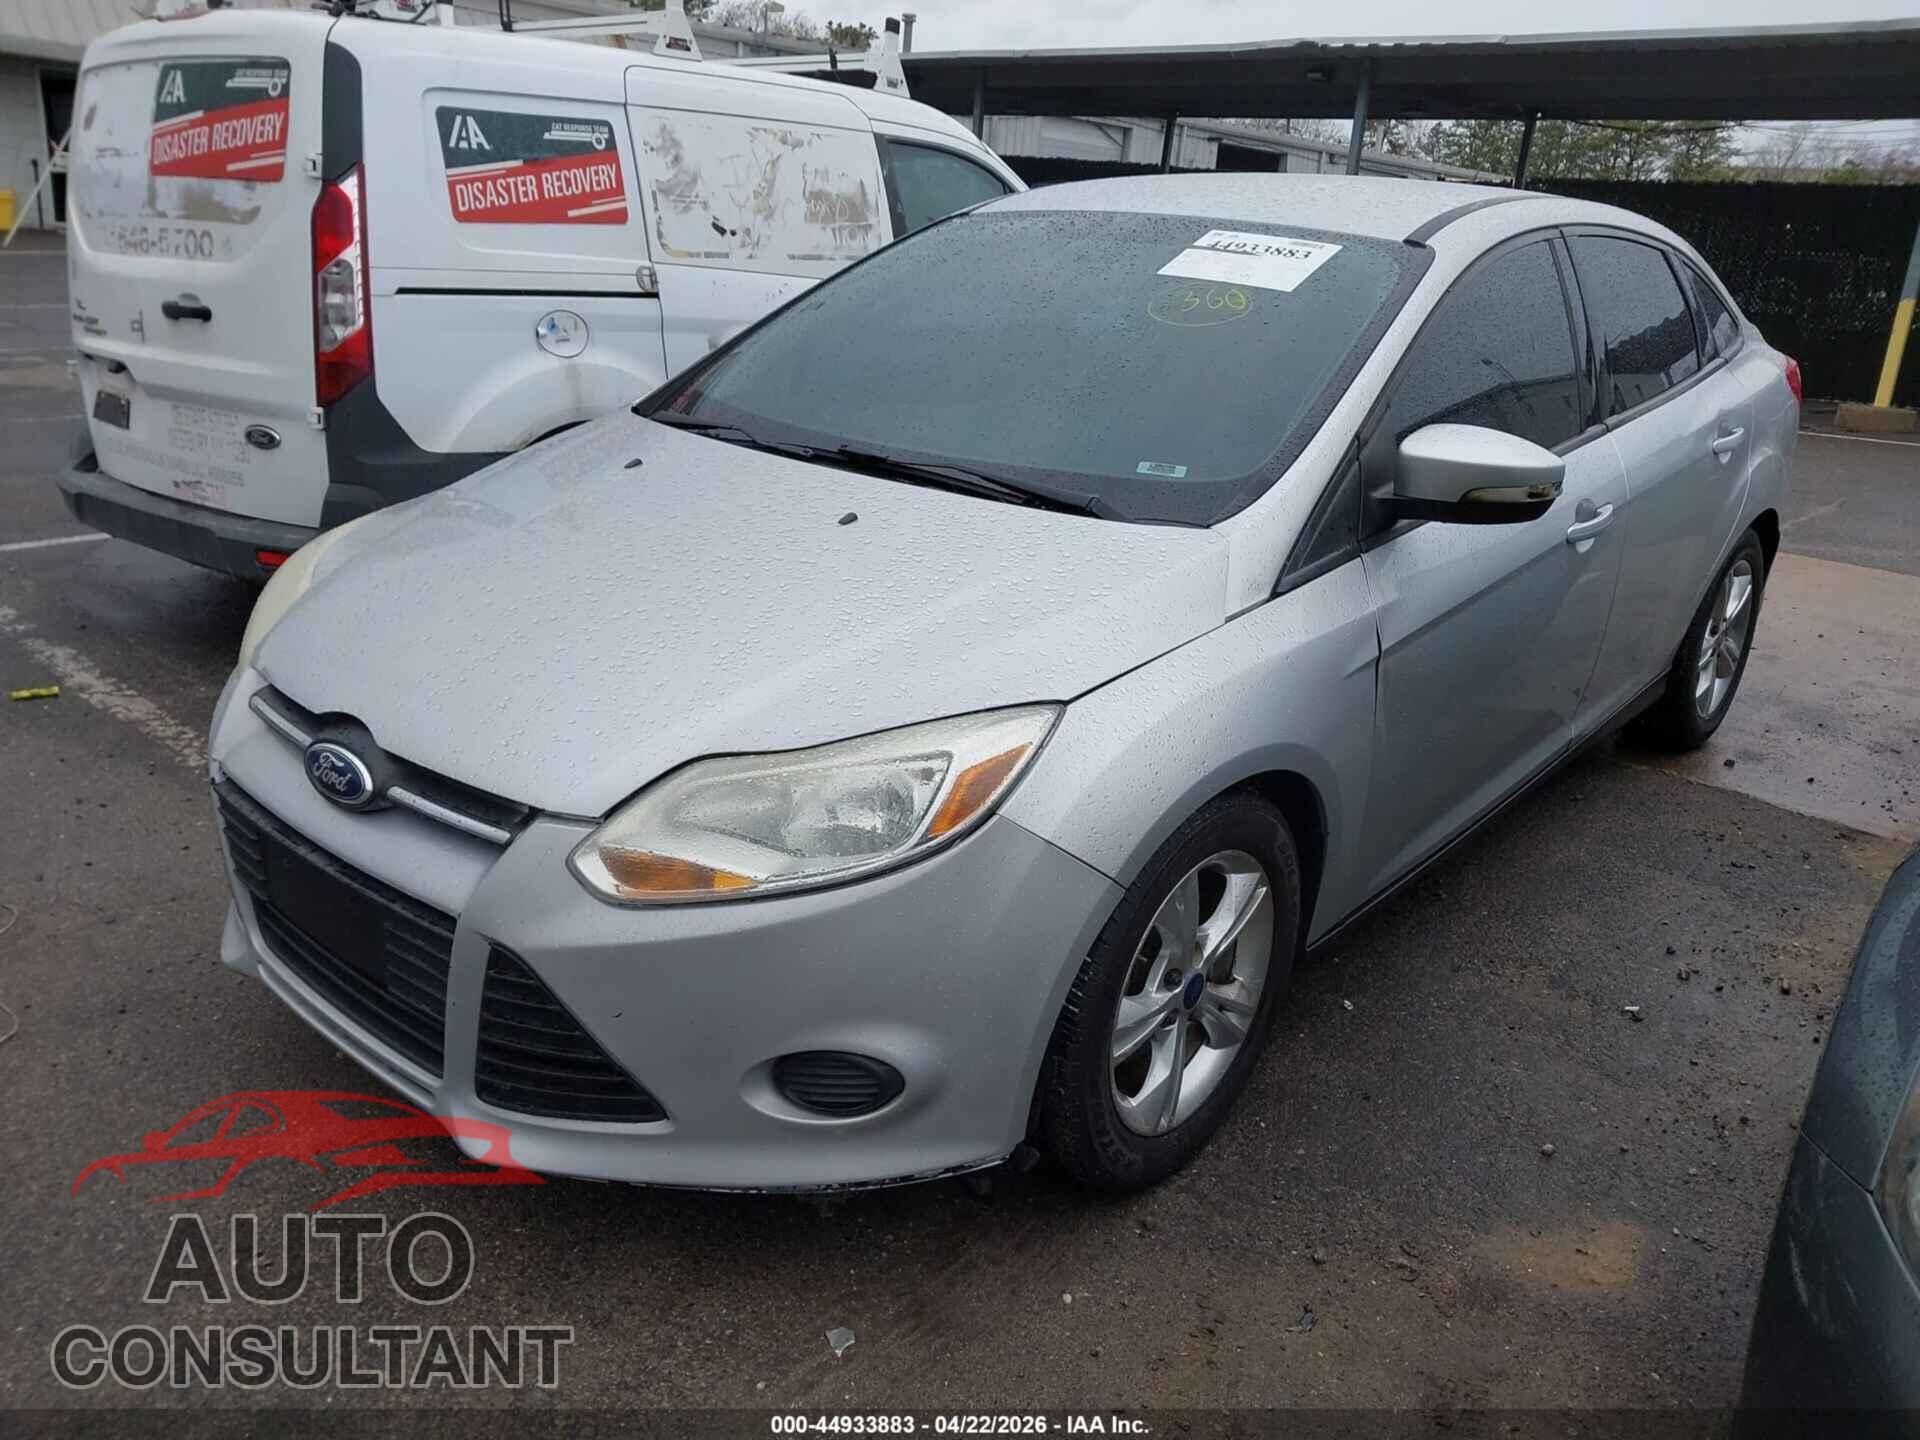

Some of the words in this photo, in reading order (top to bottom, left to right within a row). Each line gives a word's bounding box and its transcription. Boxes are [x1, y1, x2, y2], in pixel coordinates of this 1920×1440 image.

[152, 126, 209, 165] DISASTER
[211, 112, 285, 151] RECOVERY
[455, 174, 539, 213] DISASTER
[541, 163, 617, 200] RECOVERY
[313, 752, 352, 792] Ford
